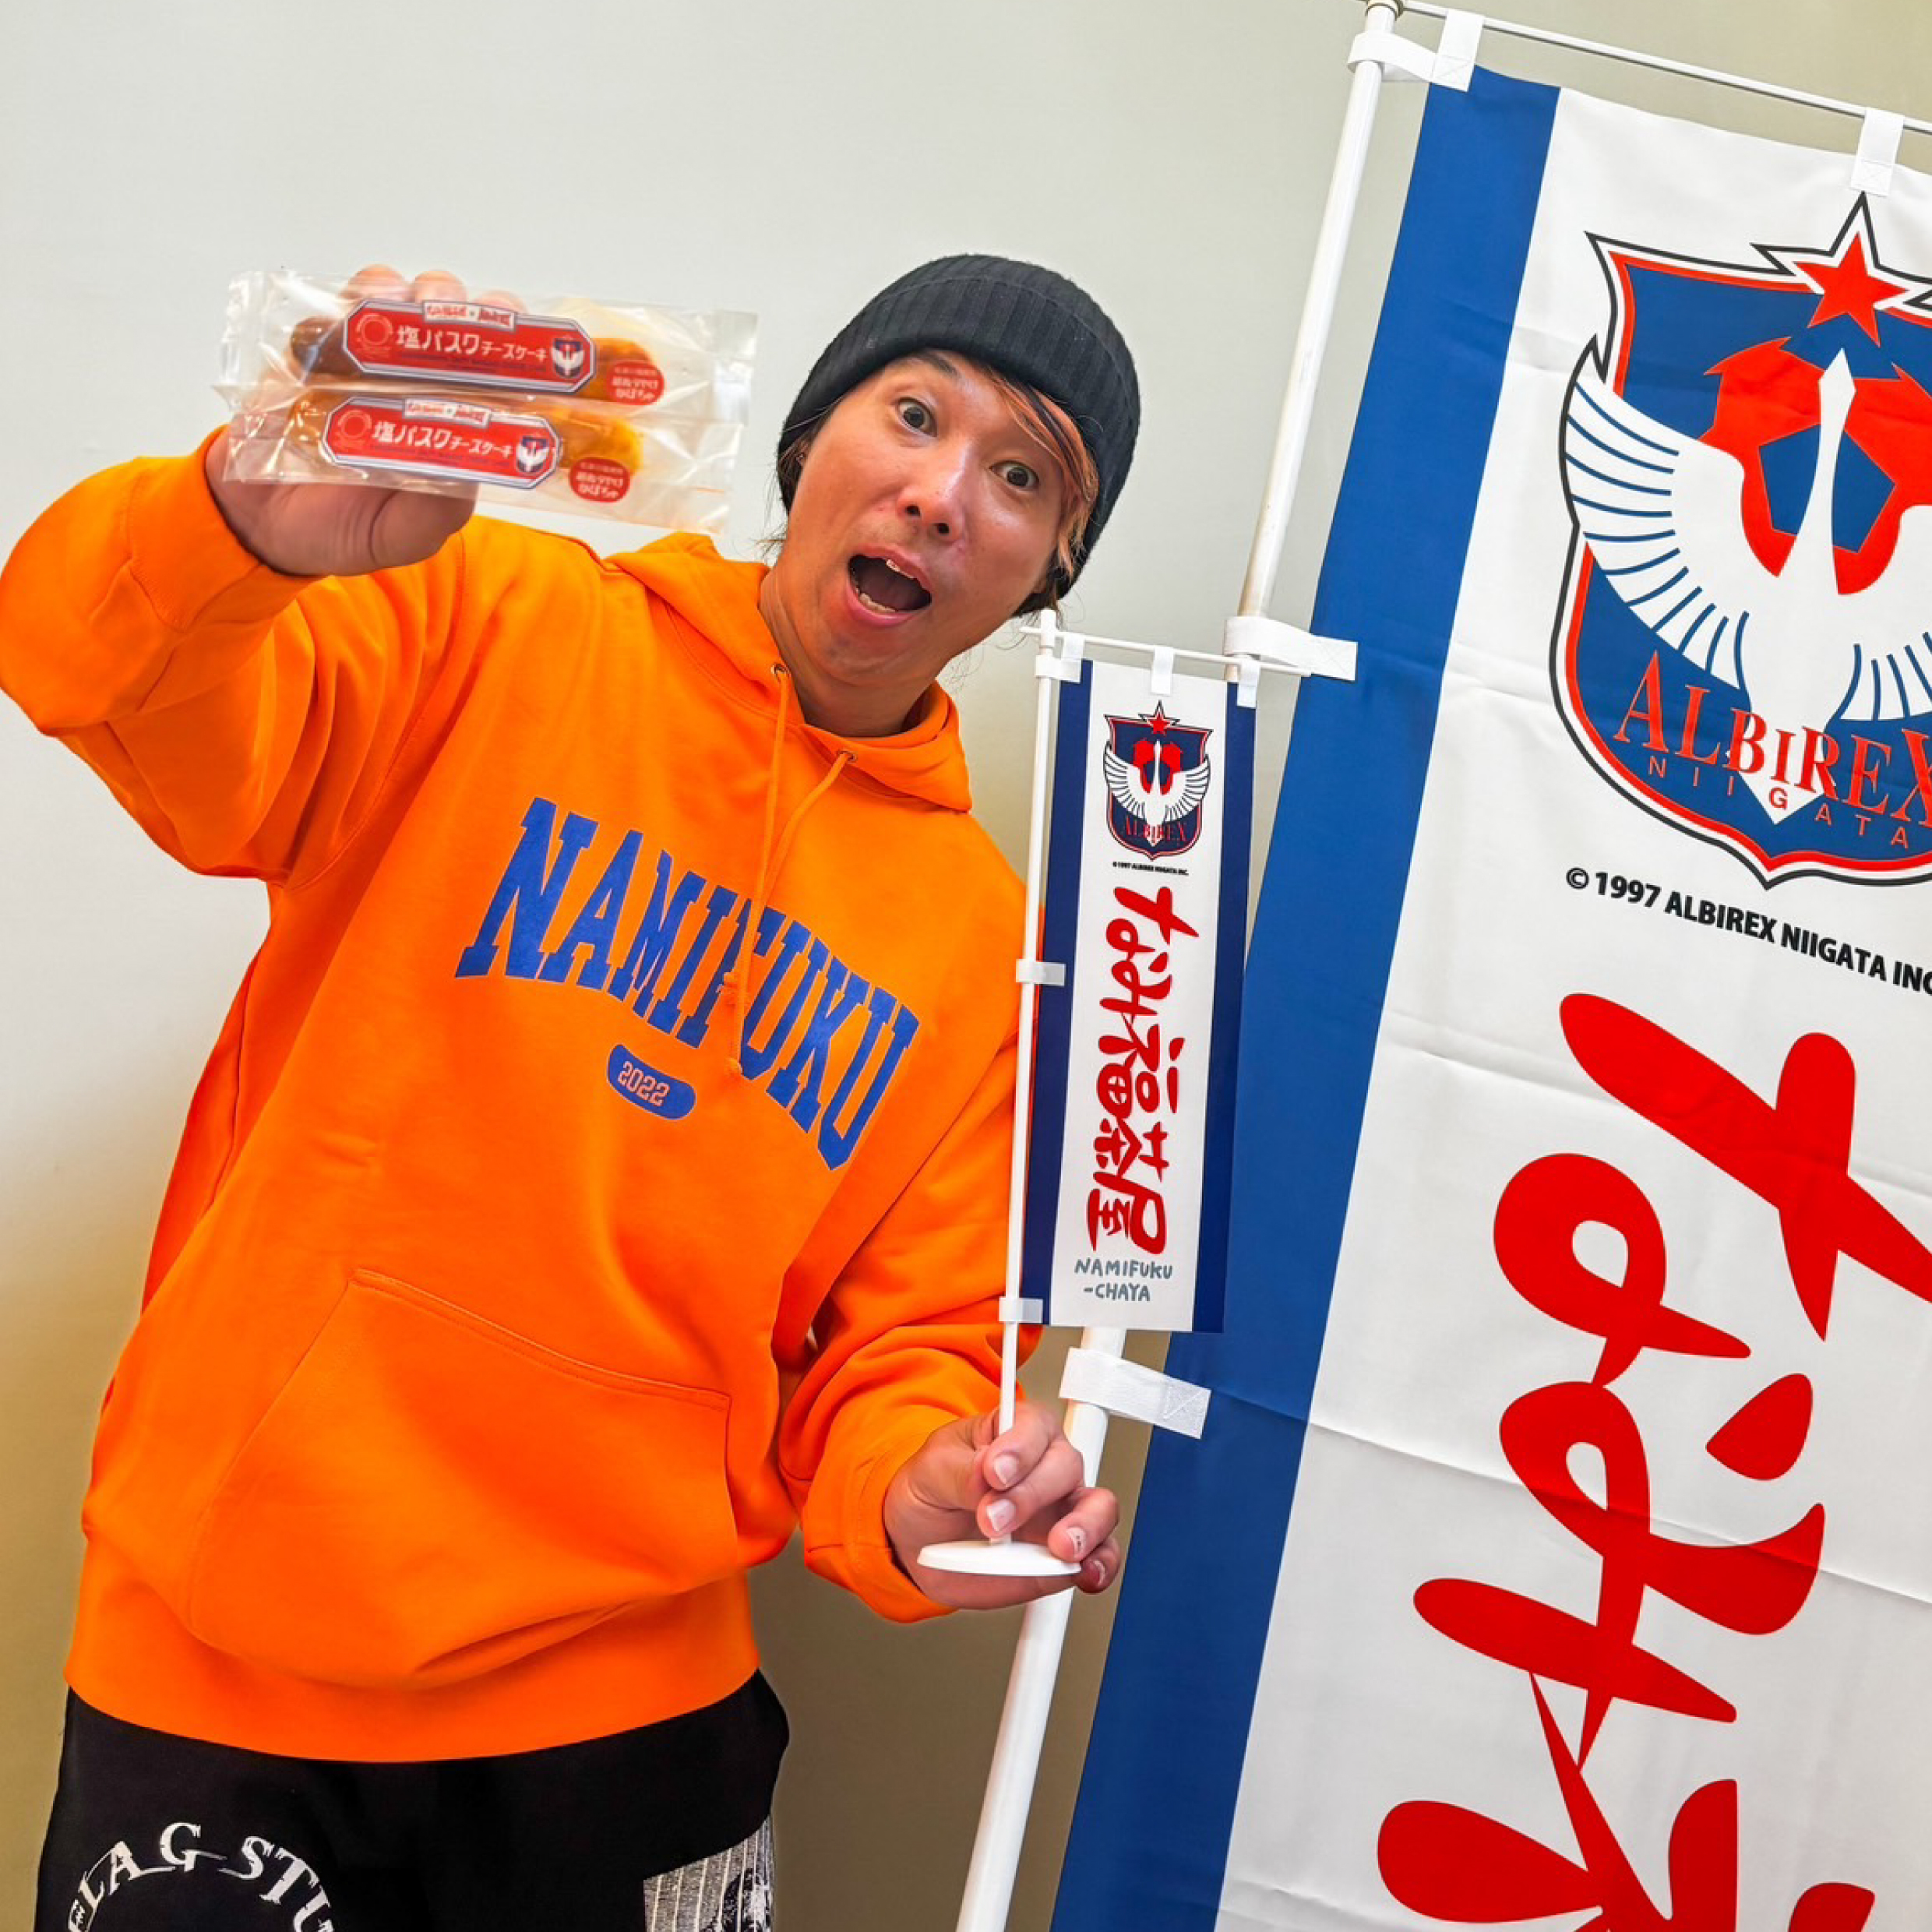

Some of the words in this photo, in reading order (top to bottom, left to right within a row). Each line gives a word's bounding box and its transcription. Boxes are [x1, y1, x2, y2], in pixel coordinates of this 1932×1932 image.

[1613, 650, 1932, 828] ALBIREX
[1648, 755, 1909, 849] NIIGATA
[1595, 871, 1662, 908] 1997
[1664, 890, 1778, 944] ALBIREX
[1781, 922, 1888, 982] NIIGATA
[456, 796, 920, 1171] NAMIFUKU
[618, 1061, 671, 1107] 2022
[1087, 887, 1199, 1255] なみ福茶屋
[1074, 1257, 1173, 1279] NAMIFUKU
[1083, 1282, 1151, 1302] -CHAYA
